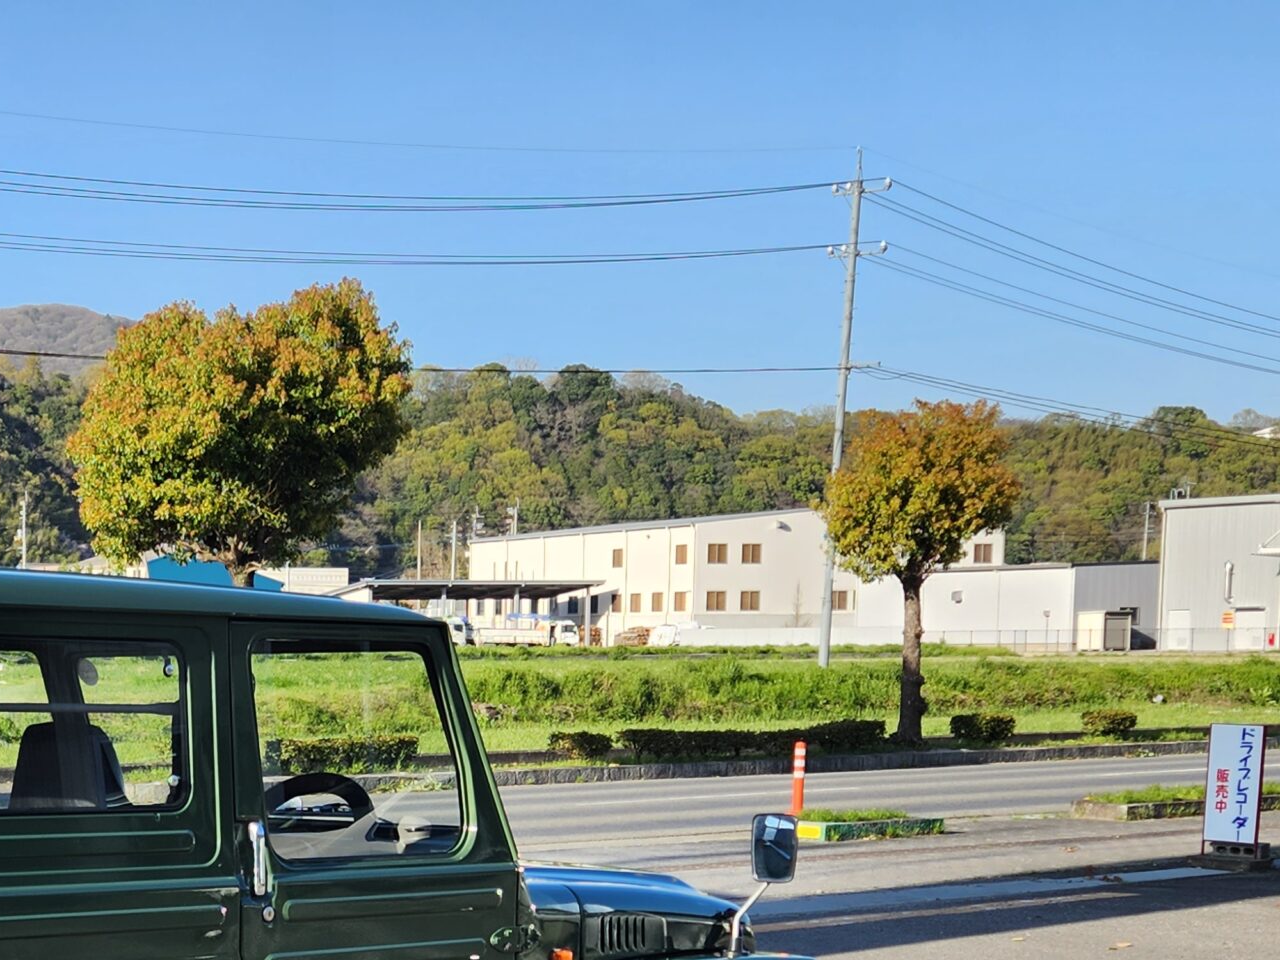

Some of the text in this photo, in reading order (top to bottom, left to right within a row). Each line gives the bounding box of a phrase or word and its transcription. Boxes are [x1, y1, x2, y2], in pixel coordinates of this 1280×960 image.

[1214, 768, 1230, 813] 販売中
[1232, 727, 1256, 842] ドライブレコーダー
